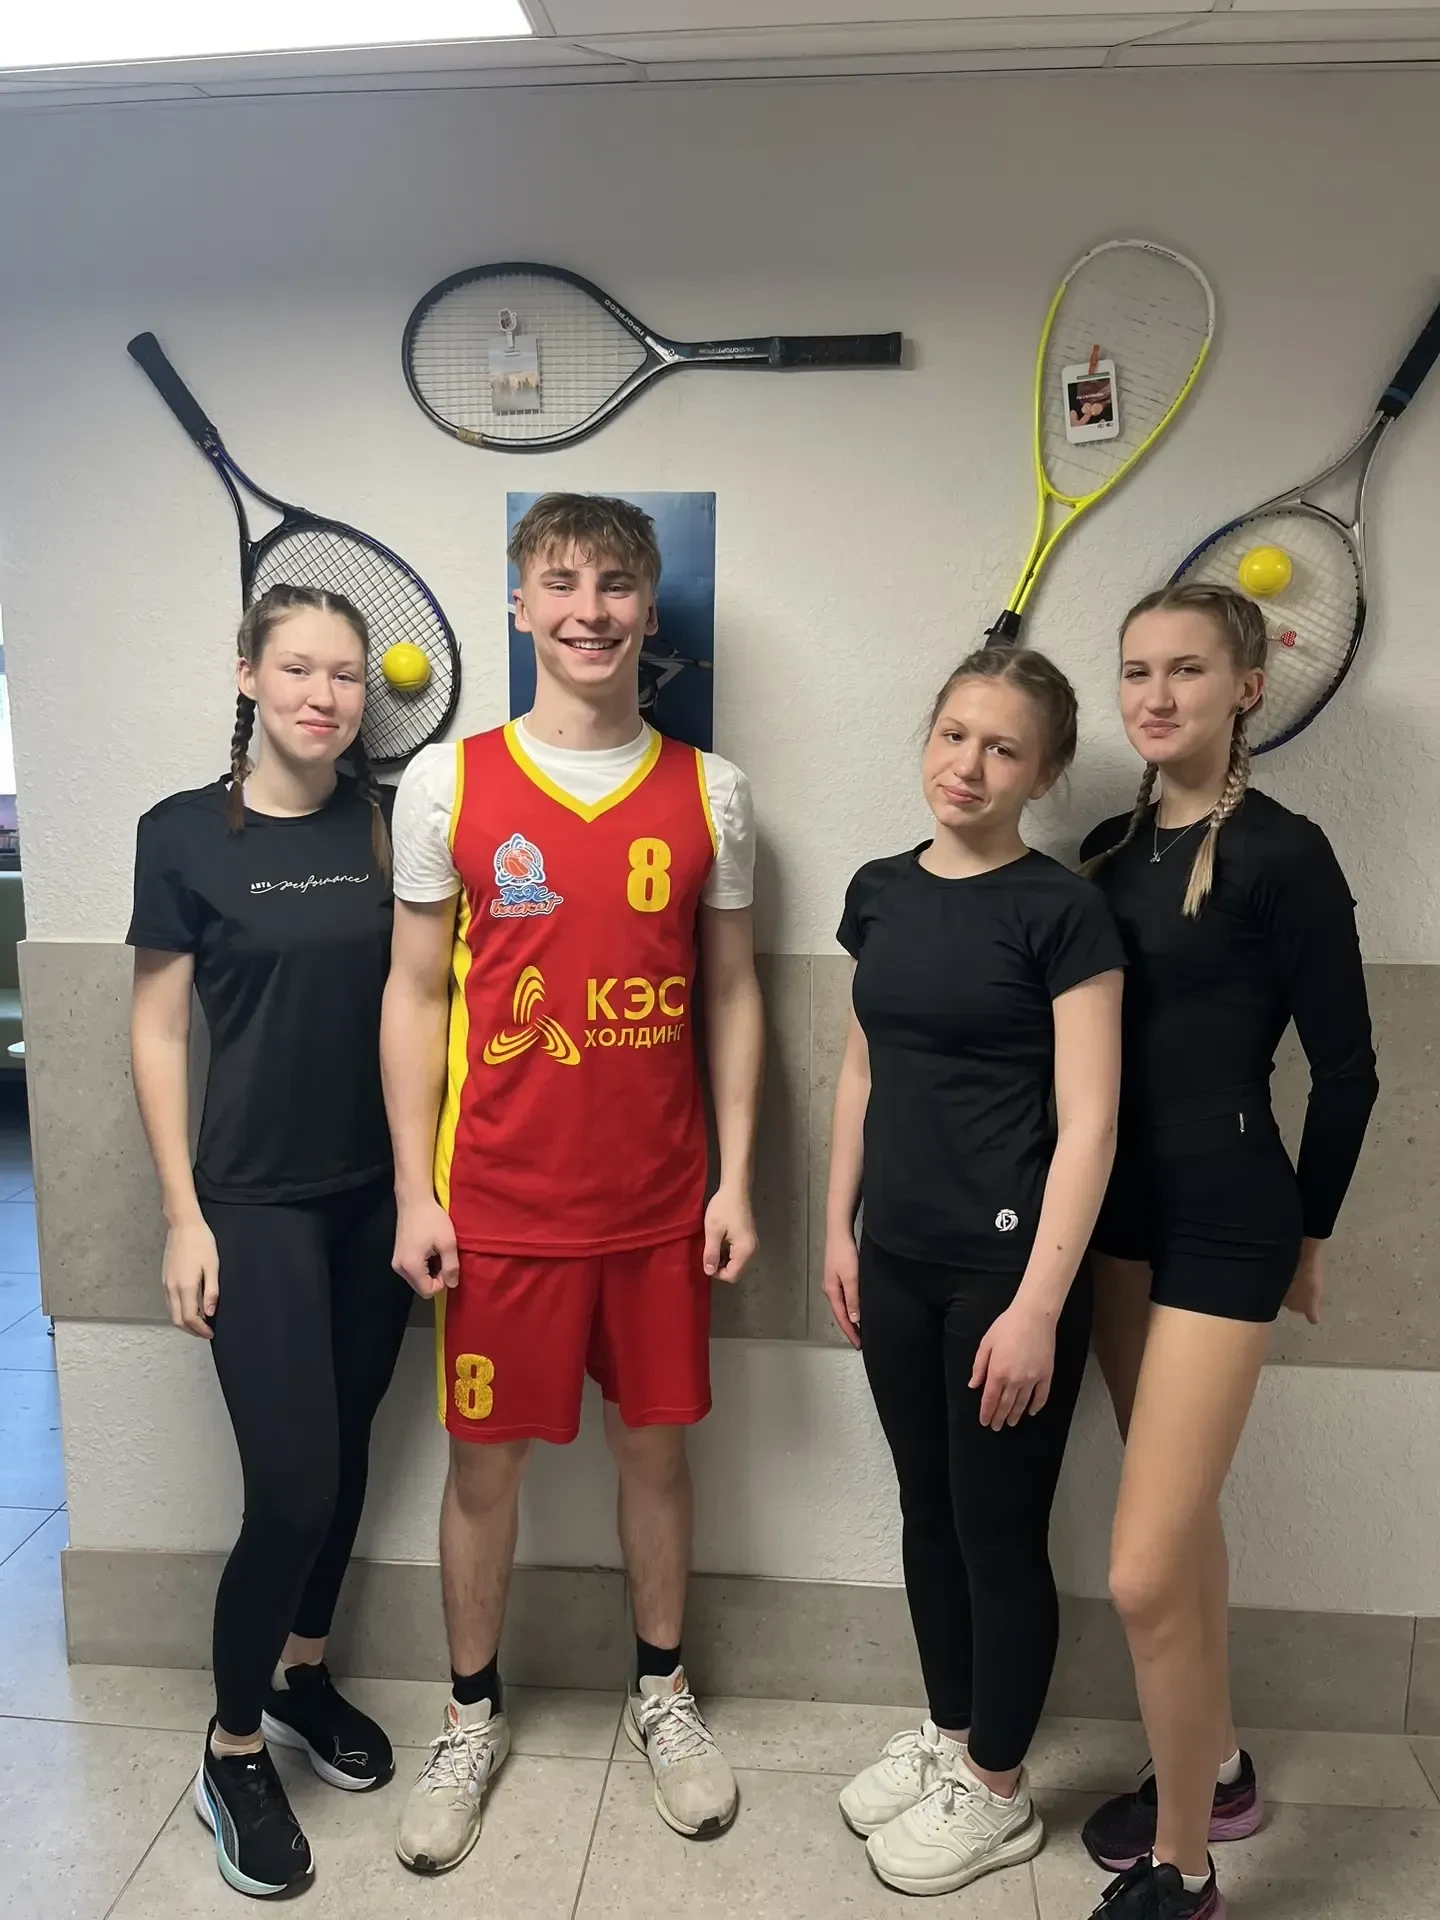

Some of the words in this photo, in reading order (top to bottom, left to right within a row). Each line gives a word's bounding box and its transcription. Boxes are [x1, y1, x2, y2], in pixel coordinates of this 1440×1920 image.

[604, 299, 645, 336] ПРОГРЕСС
[250, 873, 370, 894] performance
[627, 837, 672, 913] 8
[586, 975, 686, 1021] КЭС
[584, 1022, 685, 1049] ХОЛДИНГ
[454, 1353, 495, 1420] 8
